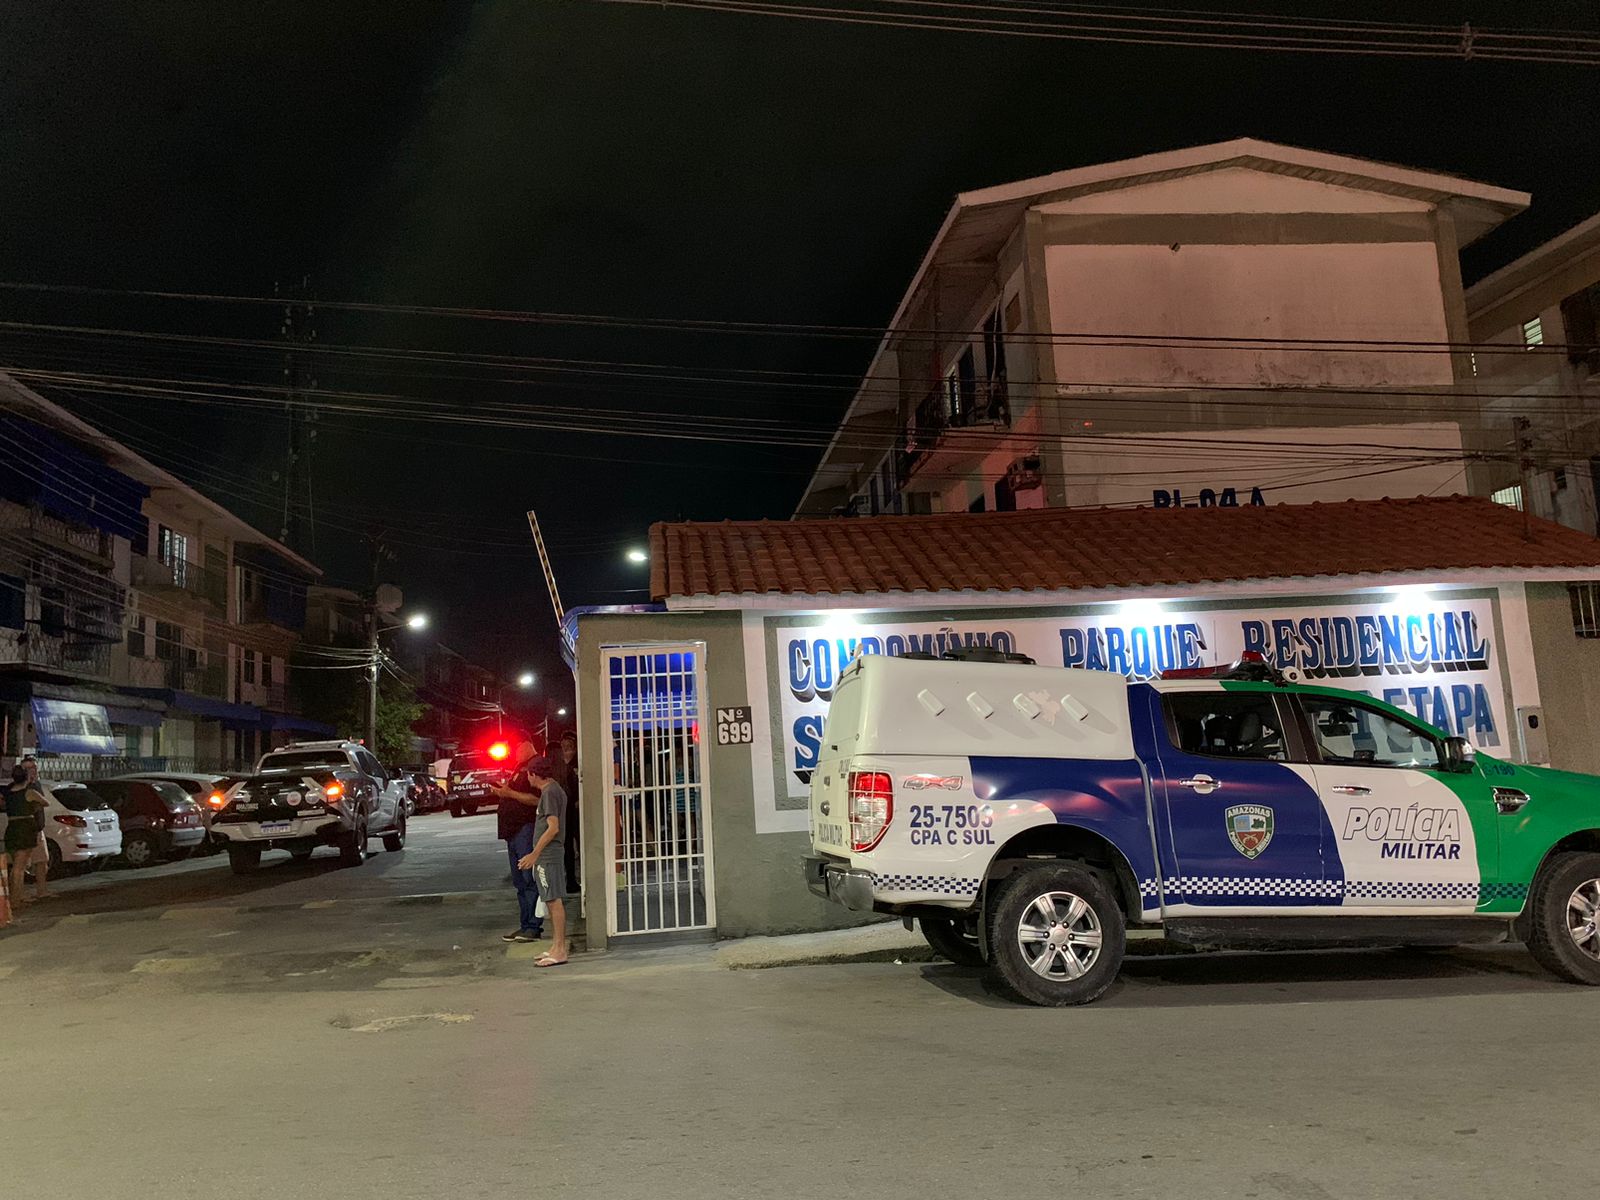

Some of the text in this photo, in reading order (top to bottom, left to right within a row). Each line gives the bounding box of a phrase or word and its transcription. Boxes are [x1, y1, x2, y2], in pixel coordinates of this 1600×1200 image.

[1059, 623, 1203, 679] PARQUE
[1240, 611, 1488, 670] RESIDENCIAL
[718, 721, 752, 744] 699
[1228, 806, 1271, 818] AMAZONAS
[1342, 802, 1460, 841] POLÍCIA
[911, 830, 995, 845] CPA C SUL
[1381, 842, 1461, 859] MILITAR
